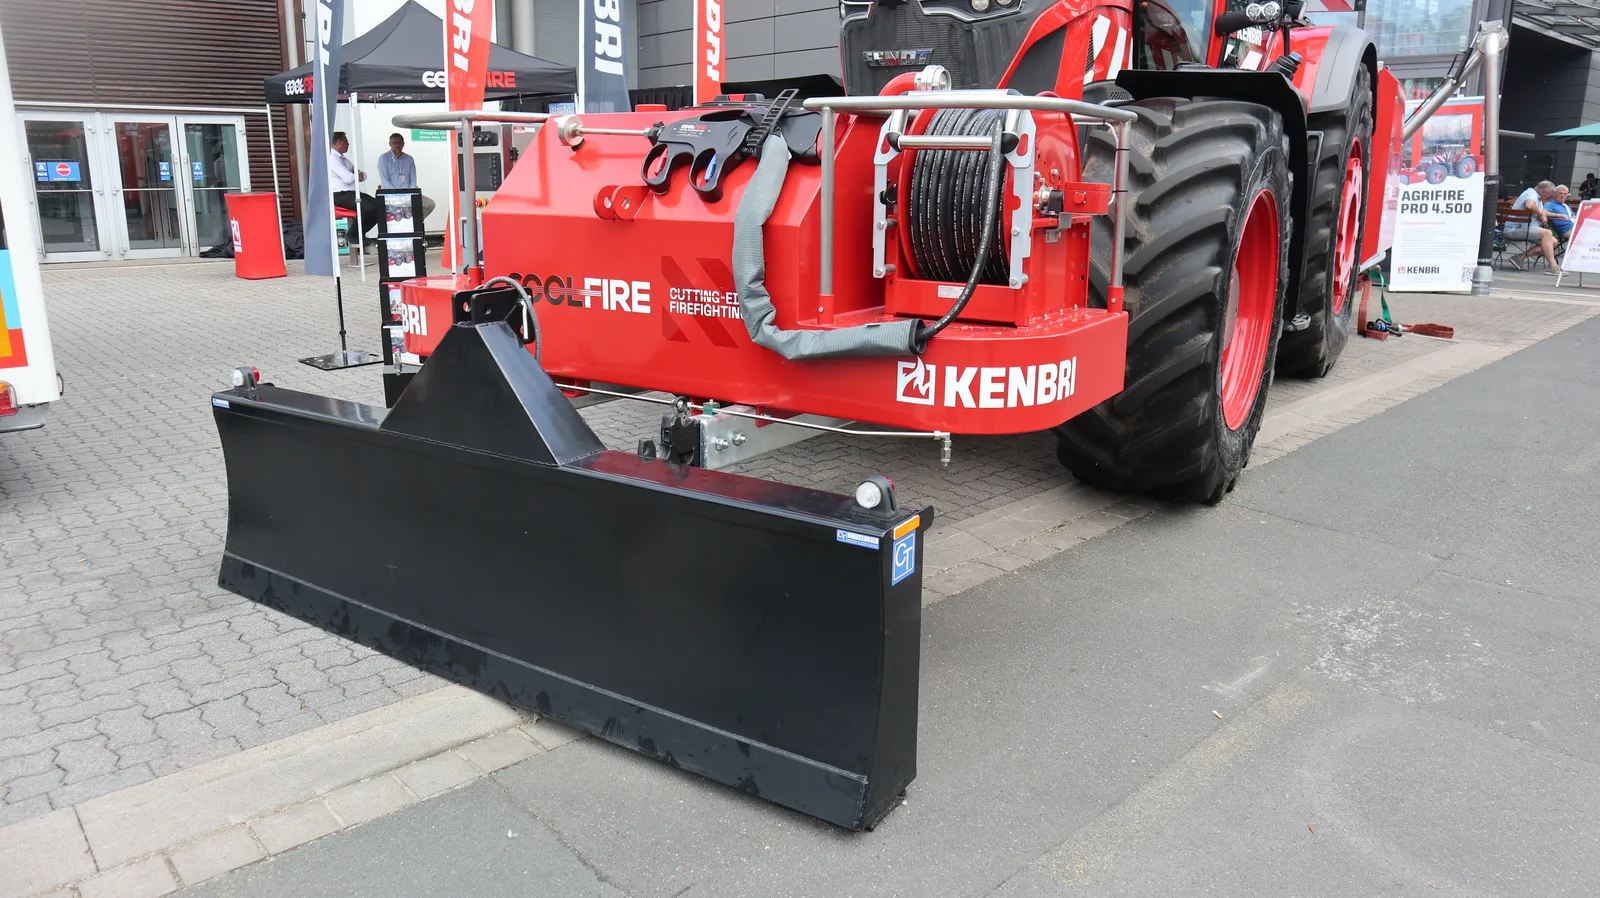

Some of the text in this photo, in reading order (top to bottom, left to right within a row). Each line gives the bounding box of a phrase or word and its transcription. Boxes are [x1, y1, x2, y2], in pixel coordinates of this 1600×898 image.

[1401, 190, 1465, 202] AGRIFIRE
[1401, 202, 1472, 214] PRO 4.500
[1406, 266, 1440, 274] KENBRI
[669, 300, 744, 319] FIREFIGHTIN
[943, 356, 1077, 409] KENBRI
[895, 542, 913, 571] CT
